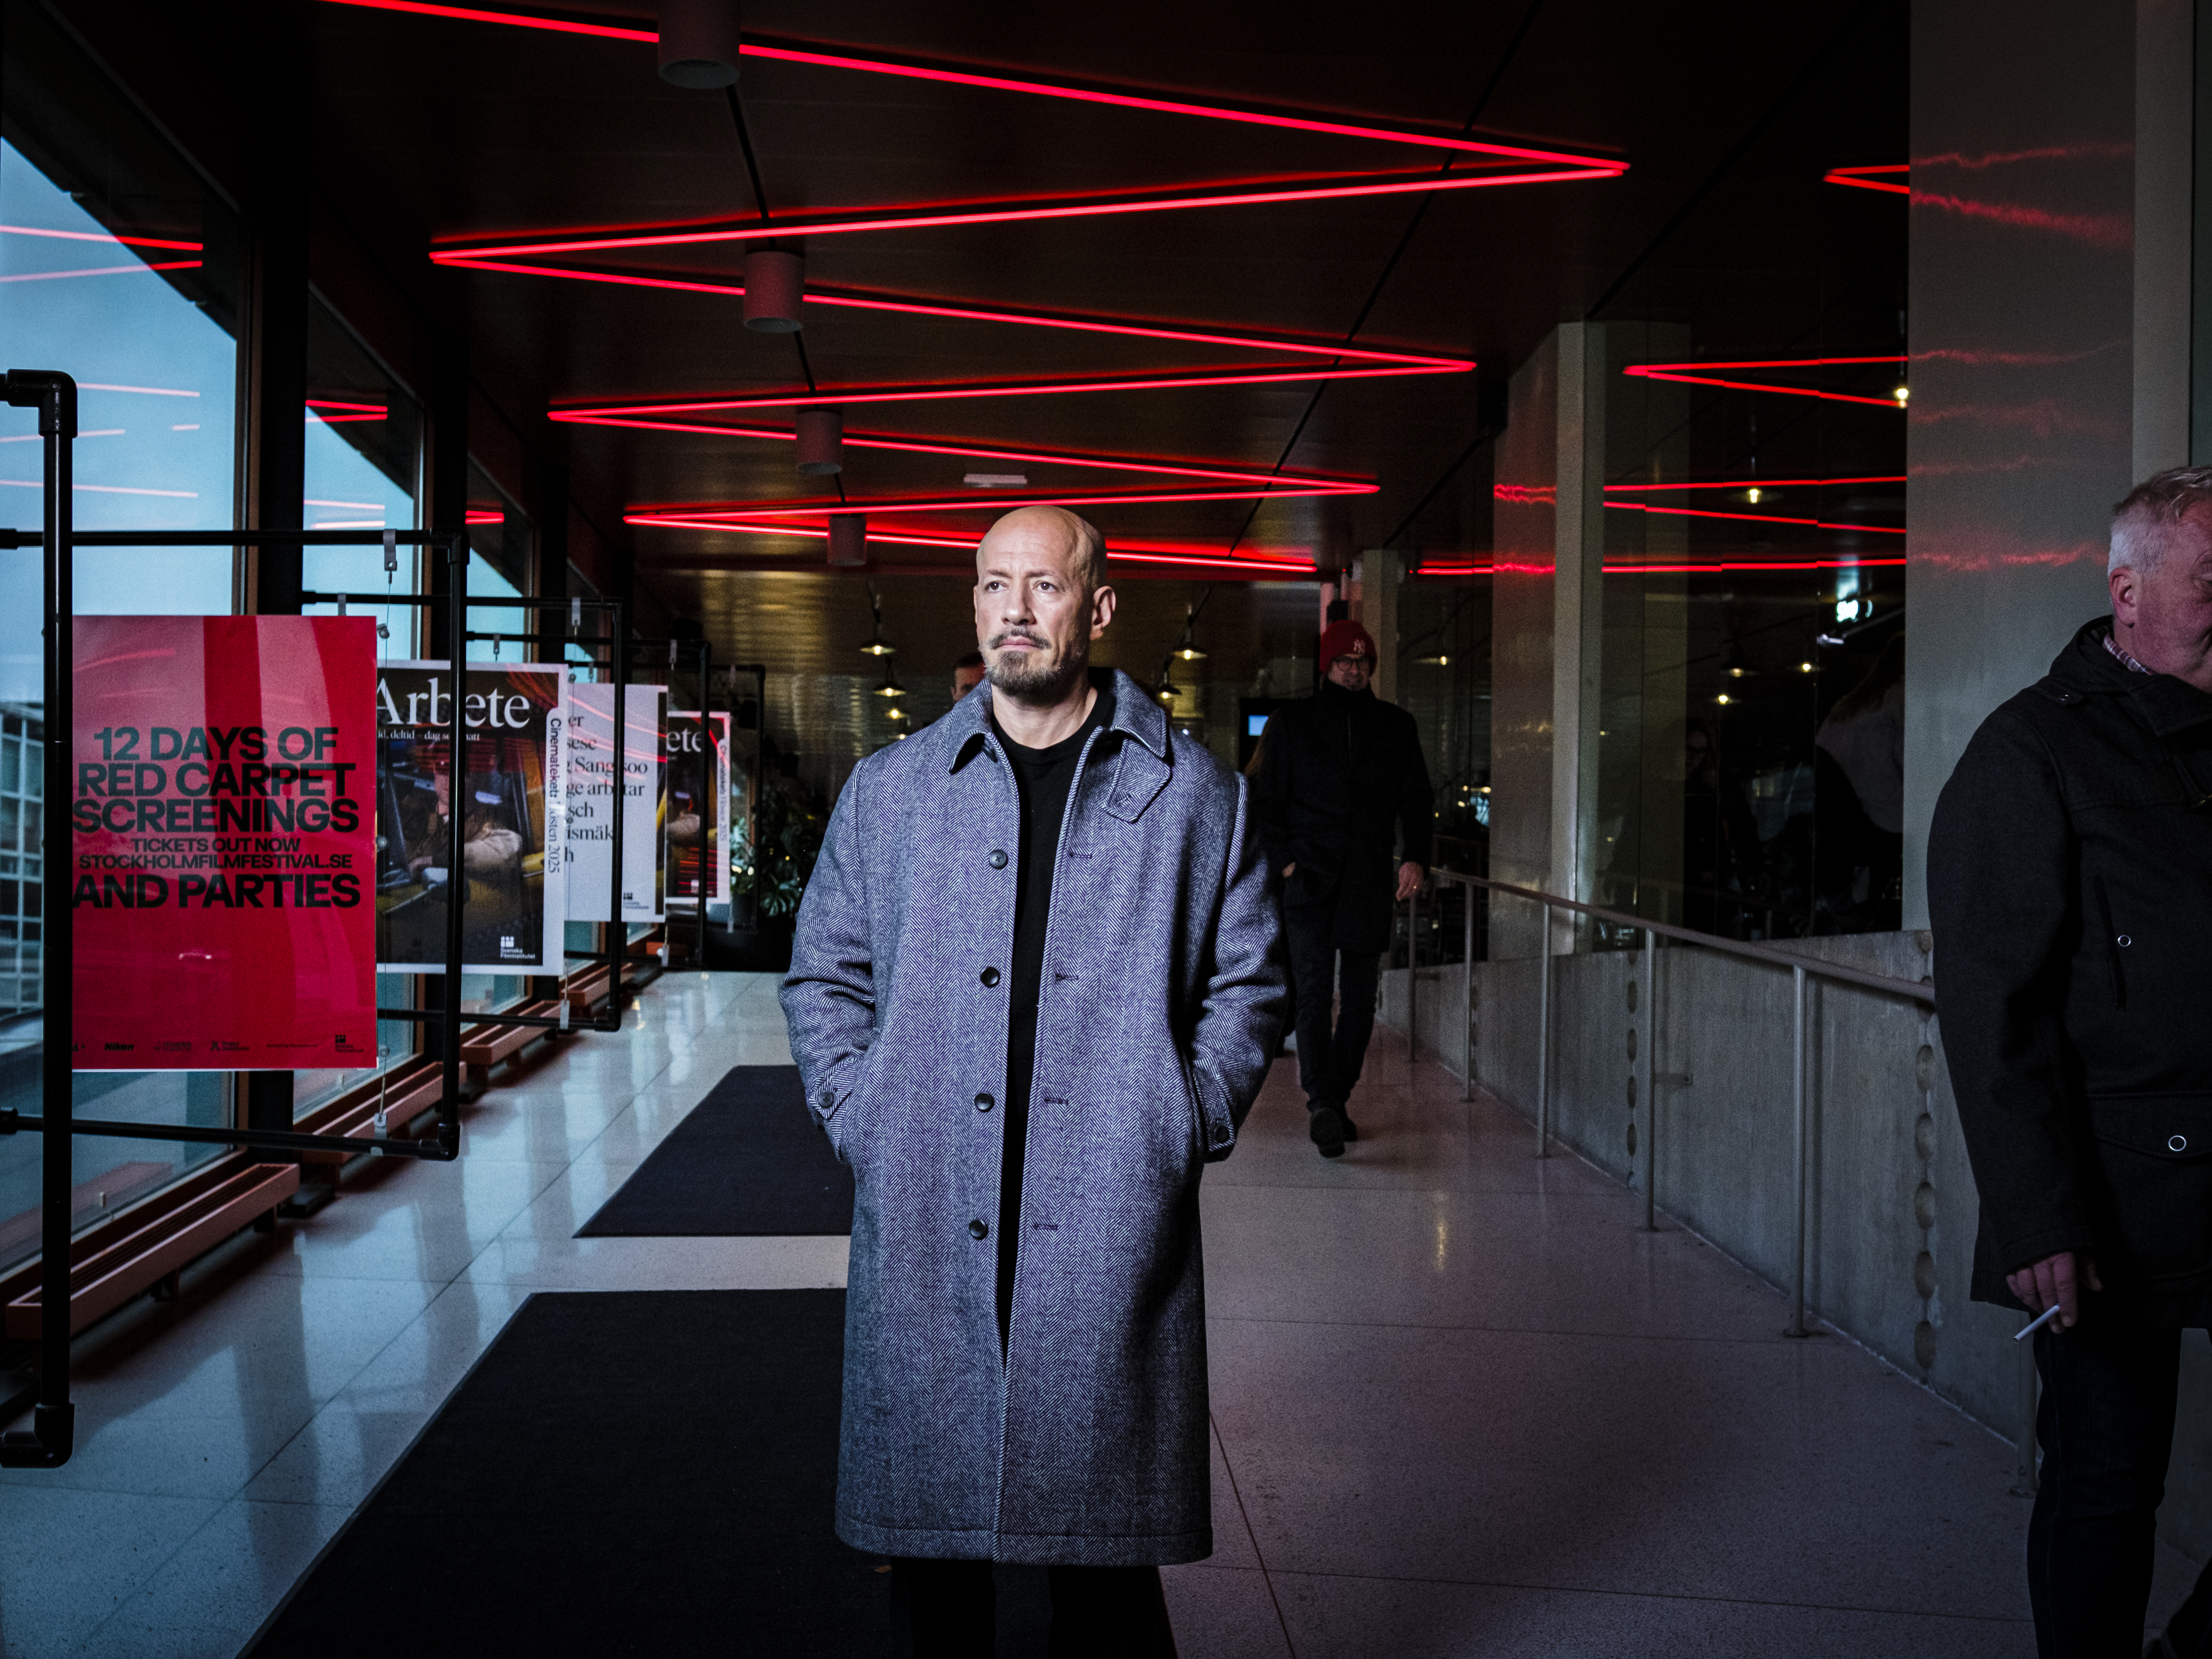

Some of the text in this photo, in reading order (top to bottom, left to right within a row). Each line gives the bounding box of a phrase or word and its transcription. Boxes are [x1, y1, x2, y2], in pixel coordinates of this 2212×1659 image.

[568, 716, 584, 727] er
[94, 727, 338, 761] 12 DAYS OF
[424, 730, 440, 741] dag
[667, 728, 701, 753] ete
[549, 717, 561, 797] Cinemateket:
[78, 762, 356, 797] RED CARPET
[566, 783, 583, 799] ge
[72, 798, 359, 833] SCREENINGS
[568, 801, 594, 818] sch
[131, 838, 301, 853] TICKETS OUT NOW
[79, 854, 352, 869] STOCKHOLMFILMFESTIVAL.SE
[548, 845, 560, 873] 2025
[72, 873, 360, 908] AND PARTIES
[104, 1042, 134, 1051] Nikon
